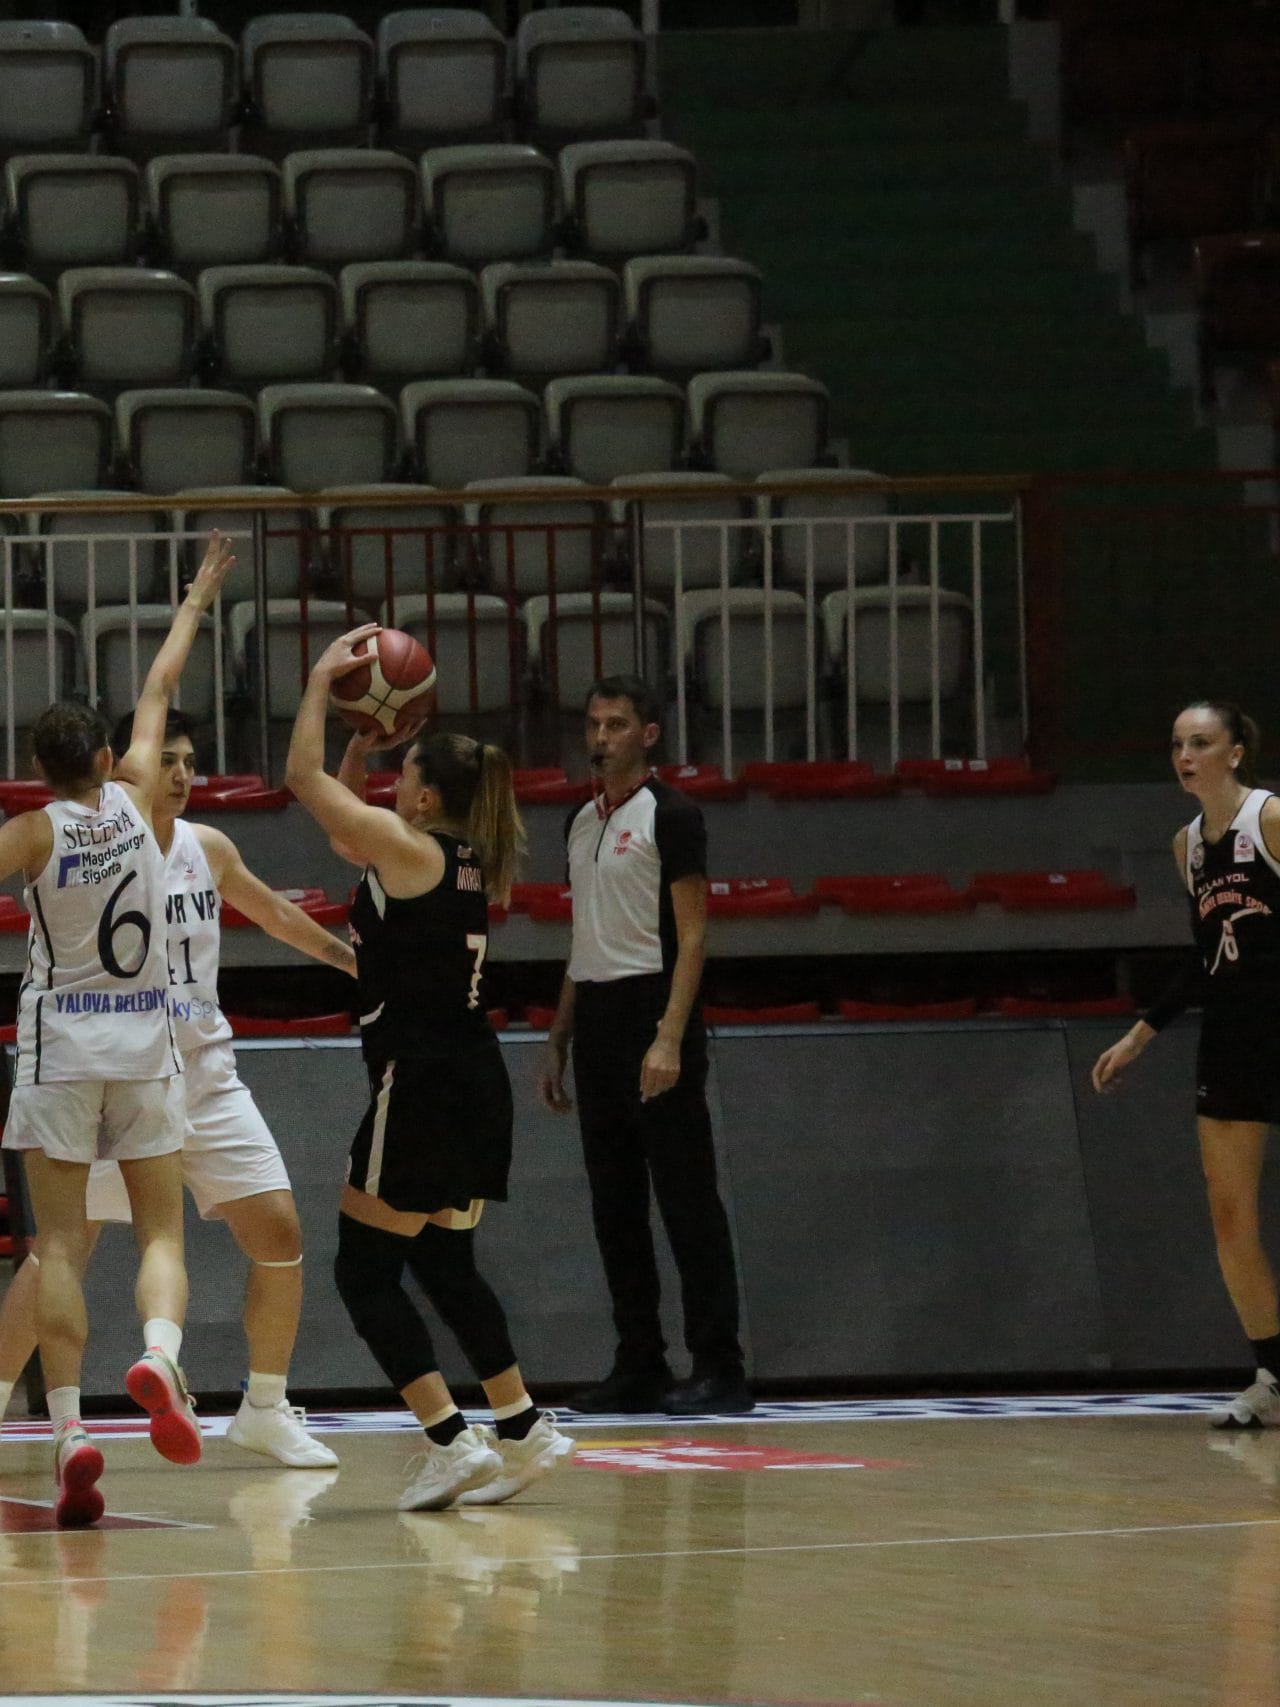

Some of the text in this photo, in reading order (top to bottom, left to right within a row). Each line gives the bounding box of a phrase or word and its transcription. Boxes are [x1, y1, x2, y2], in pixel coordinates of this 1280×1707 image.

[82, 862, 122, 885] Sigorta
[98, 869, 151, 979] 6
[466, 934, 487, 1008] 7
[55, 993, 111, 1014] YALOVA
